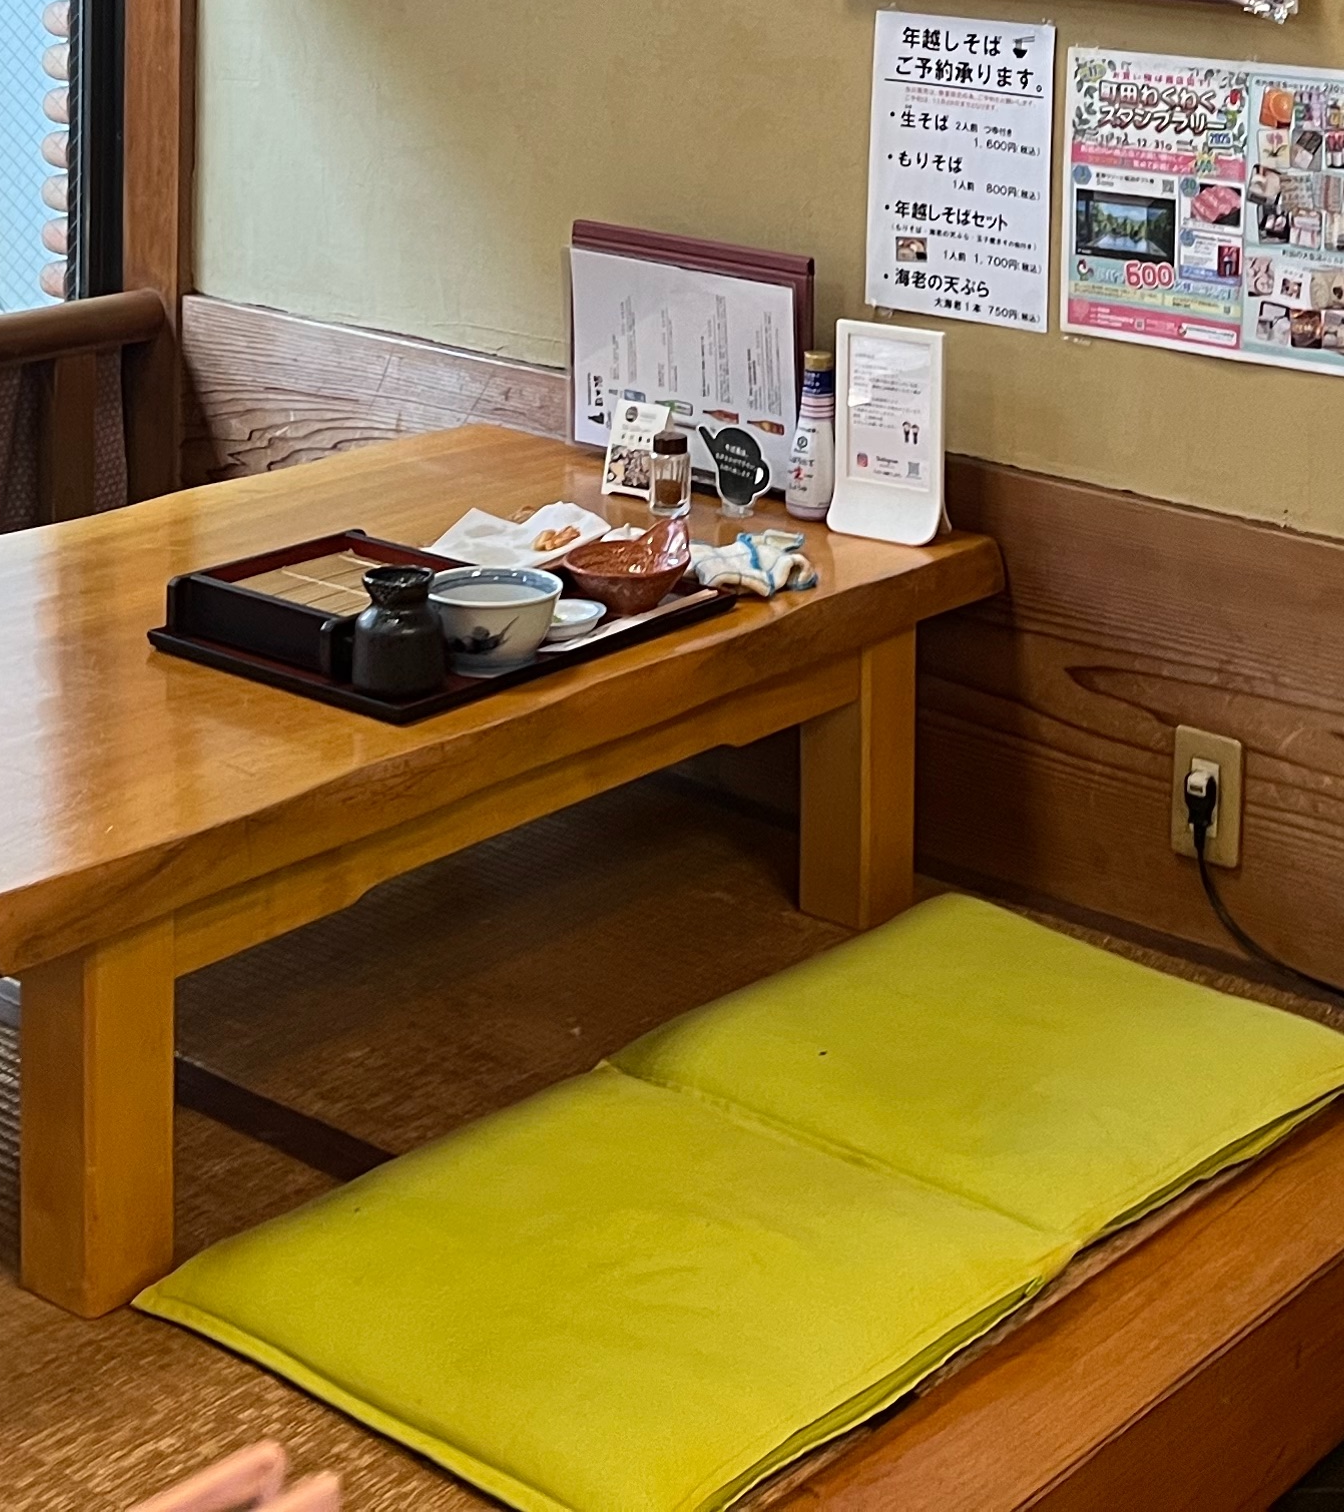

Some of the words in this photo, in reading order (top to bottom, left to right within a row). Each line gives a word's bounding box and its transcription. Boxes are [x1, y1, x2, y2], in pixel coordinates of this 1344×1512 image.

[902, 26, 1003, 57] 年越しそば
[895, 56, 1043, 93] ご予約承ります。
[1099, 80, 1217, 115] 町田わくわく
[900, 110, 950, 132] 生そば
[955, 121, 978, 134] 2人前
[1097, 104, 1228, 137] スタンプラリー
[898, 150, 963, 174] もりそば
[953, 179, 975, 192] 1人前
[895, 200, 1009, 232] 年越しそばセット
[943, 249, 967, 263] 1人前
[895, 267, 990, 298] 海老の天ぷら
[1124, 261, 1175, 290] 600
